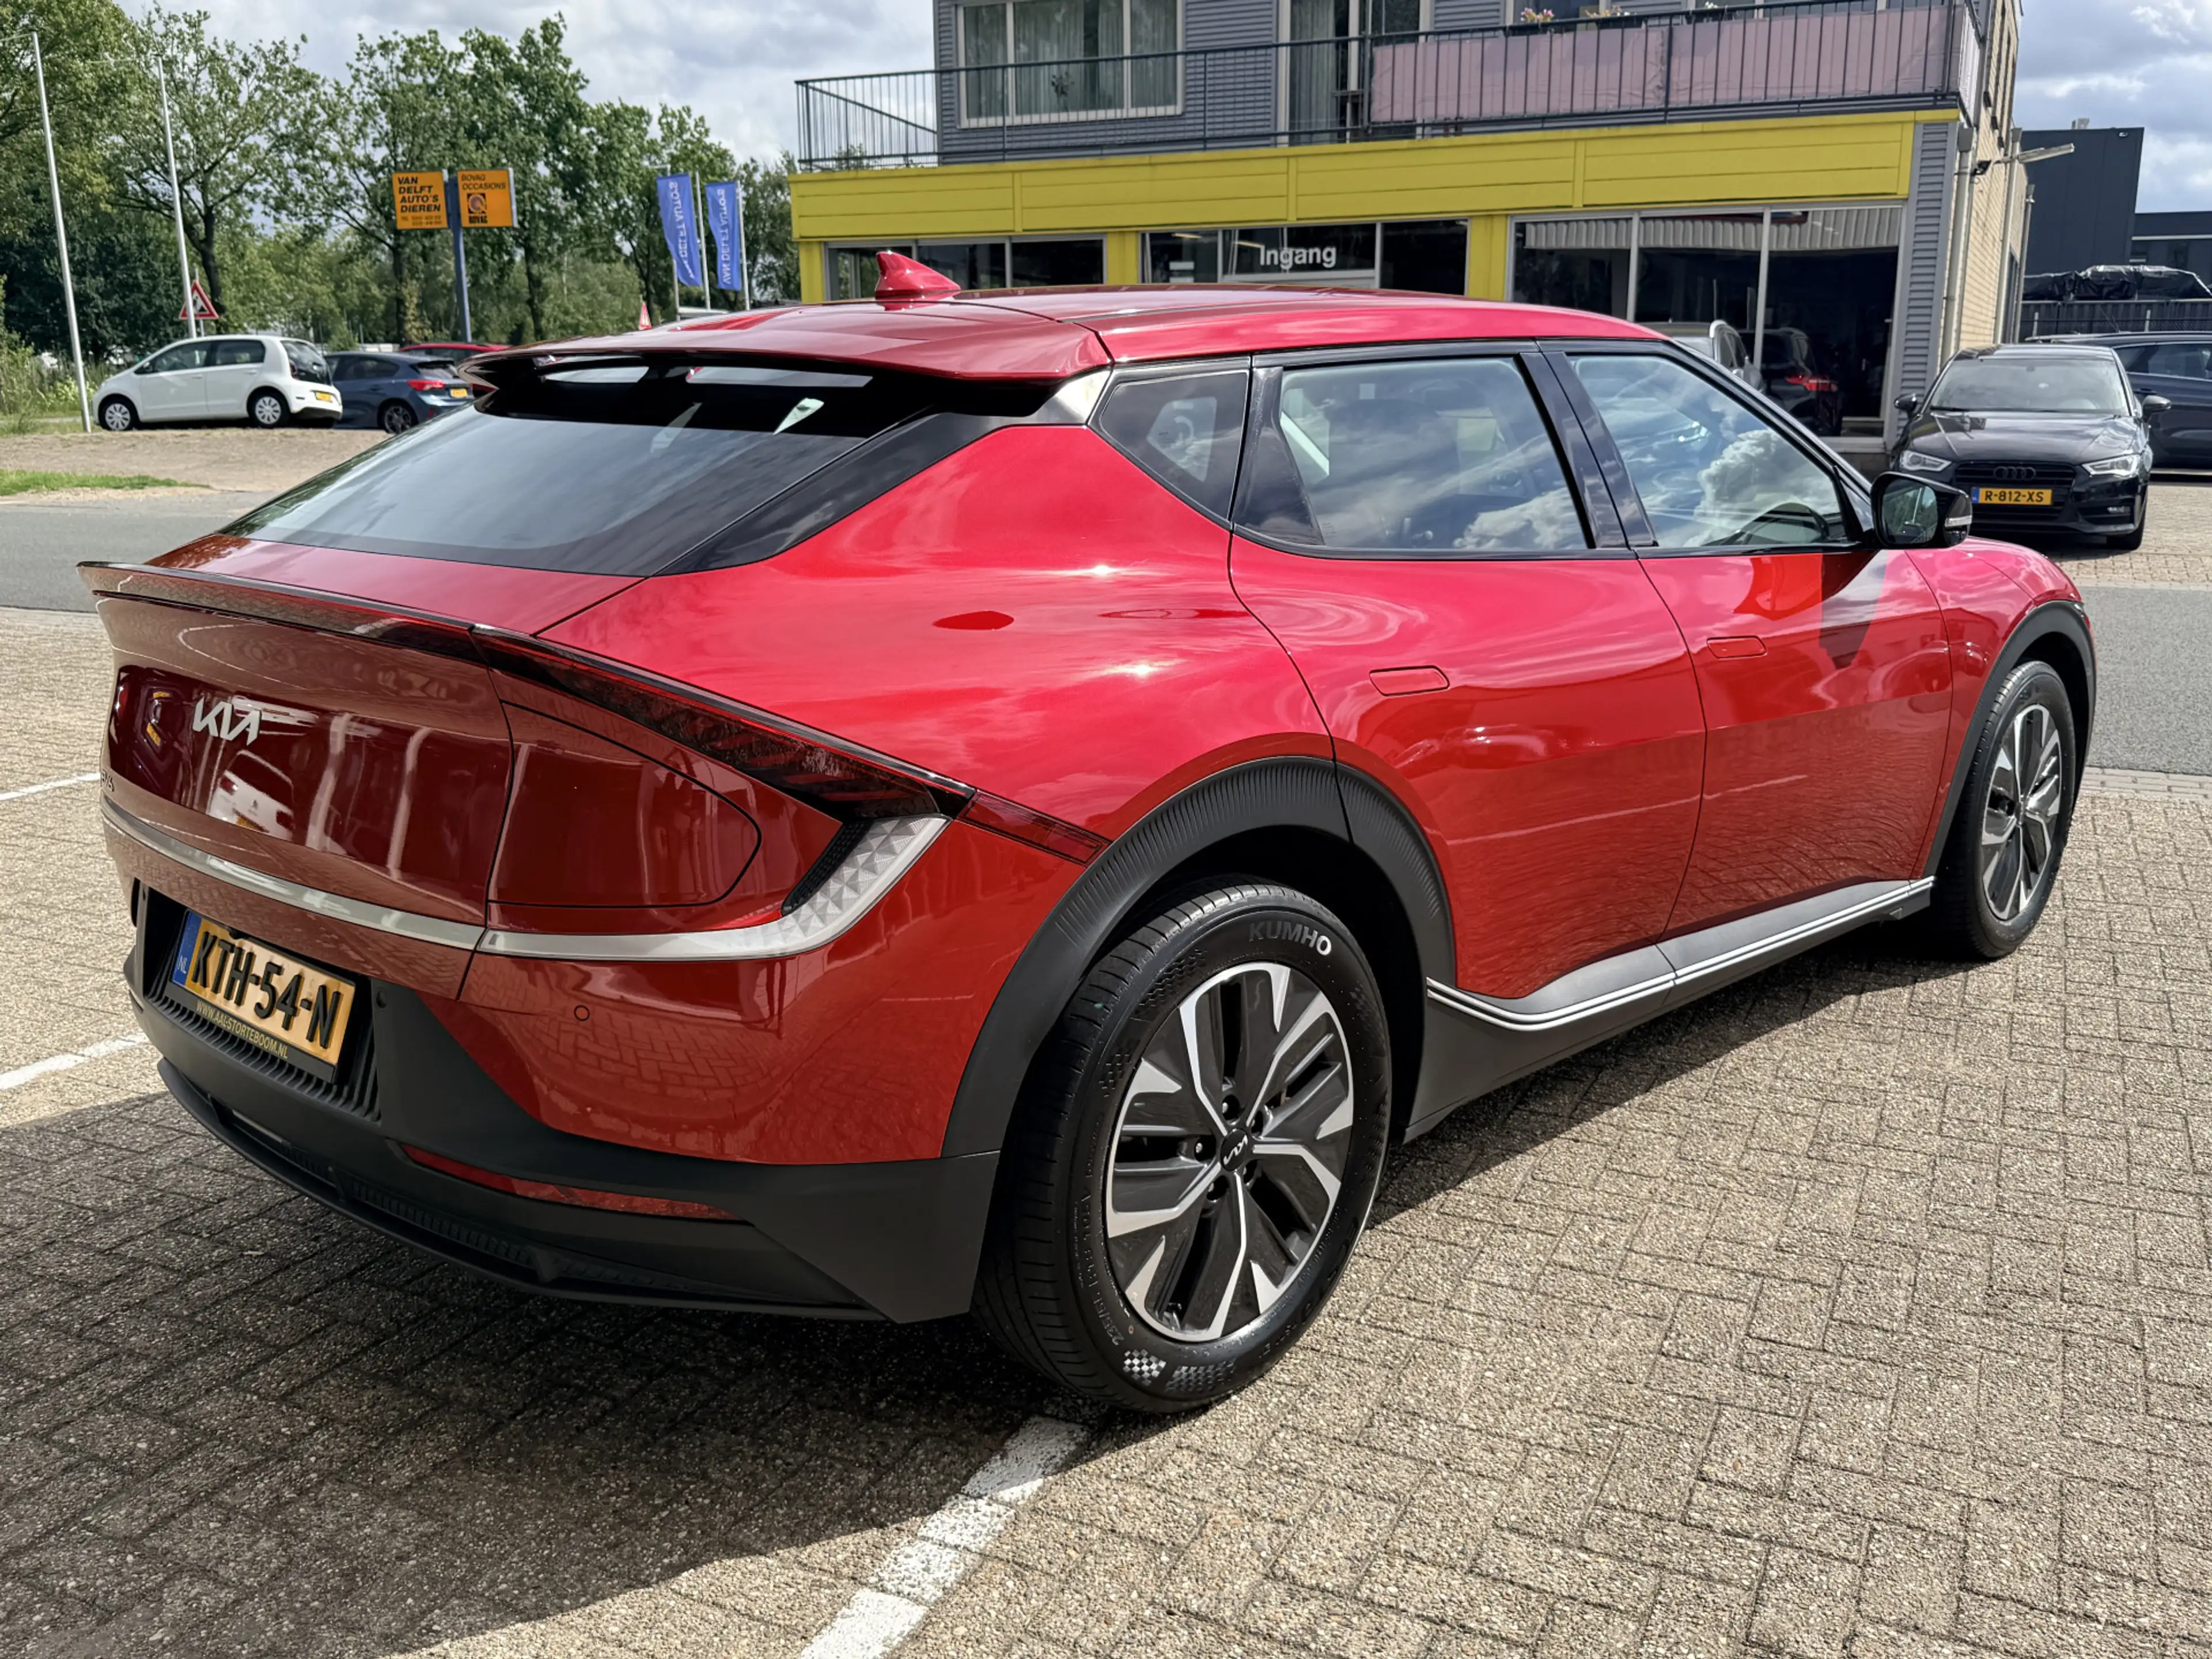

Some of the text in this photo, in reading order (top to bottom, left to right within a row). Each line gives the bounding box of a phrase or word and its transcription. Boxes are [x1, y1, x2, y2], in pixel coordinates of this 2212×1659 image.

[397, 177, 418, 185] VAN
[462, 182, 506, 191] OCCASIONS
[399, 185, 433, 194] DELFT
[400, 195, 439, 203] AUTO'S
[400, 204, 441, 213] DIEREN
[1260, 245, 1336, 268] Ingang
[1984, 490, 2044, 502] R-812-XS
[192, 696, 262, 745] KIA
[1248, 921, 1332, 956] KUMHO
[177, 955, 187, 975] NL
[191, 931, 342, 1049] KTH-54-N
